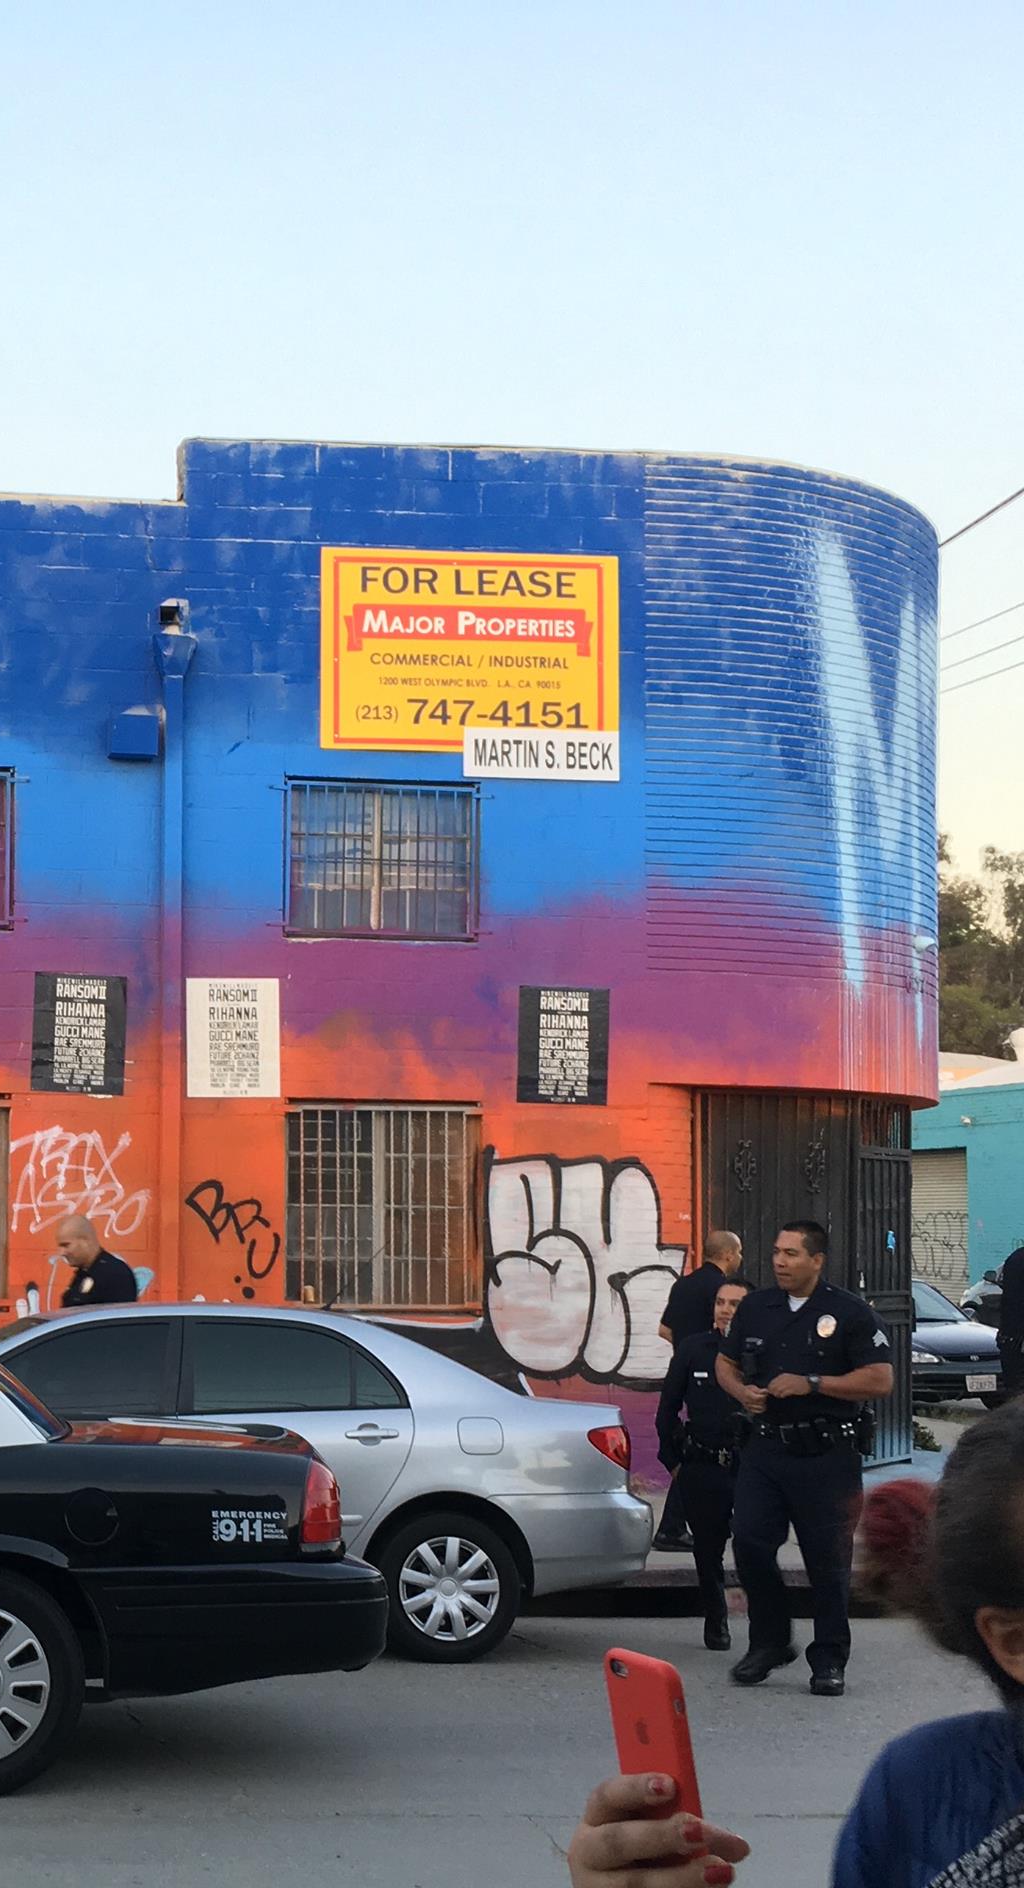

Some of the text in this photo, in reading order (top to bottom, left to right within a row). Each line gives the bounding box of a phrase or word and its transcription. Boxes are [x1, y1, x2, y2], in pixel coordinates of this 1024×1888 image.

[360, 566, 576, 598] FOR LEASE
[362, 609, 575, 638] MAJOR PROPERTIES
[370, 652, 473, 668] COMMERCIAL
[489, 656, 568, 670] INDUSTRIAL
[378, 676, 398, 686] 1200
[400, 678, 422, 686] WEST
[424, 678, 463, 687] OLYMPIC
[518, 680, 531, 688] CA
[536, 681, 560, 690] 90015
[355, 698, 589, 728] (213) 747-4151
[474, 738, 613, 770] MARTIN S. BECK
[56, 1001, 106, 1018] RIHANNA
[209, 1007, 257, 1020] RIHANNA
[540, 1014, 588, 1029] RIHANNA
[55, 1026, 106, 1039] GUCCI MANE
[209, 1031, 258, 1041] GUCCI MANE
[565, 1039, 589, 1050] MANE
[211, 1510, 288, 1519] EMERGENCY
[219, 1519, 262, 1542] 9-1-1
